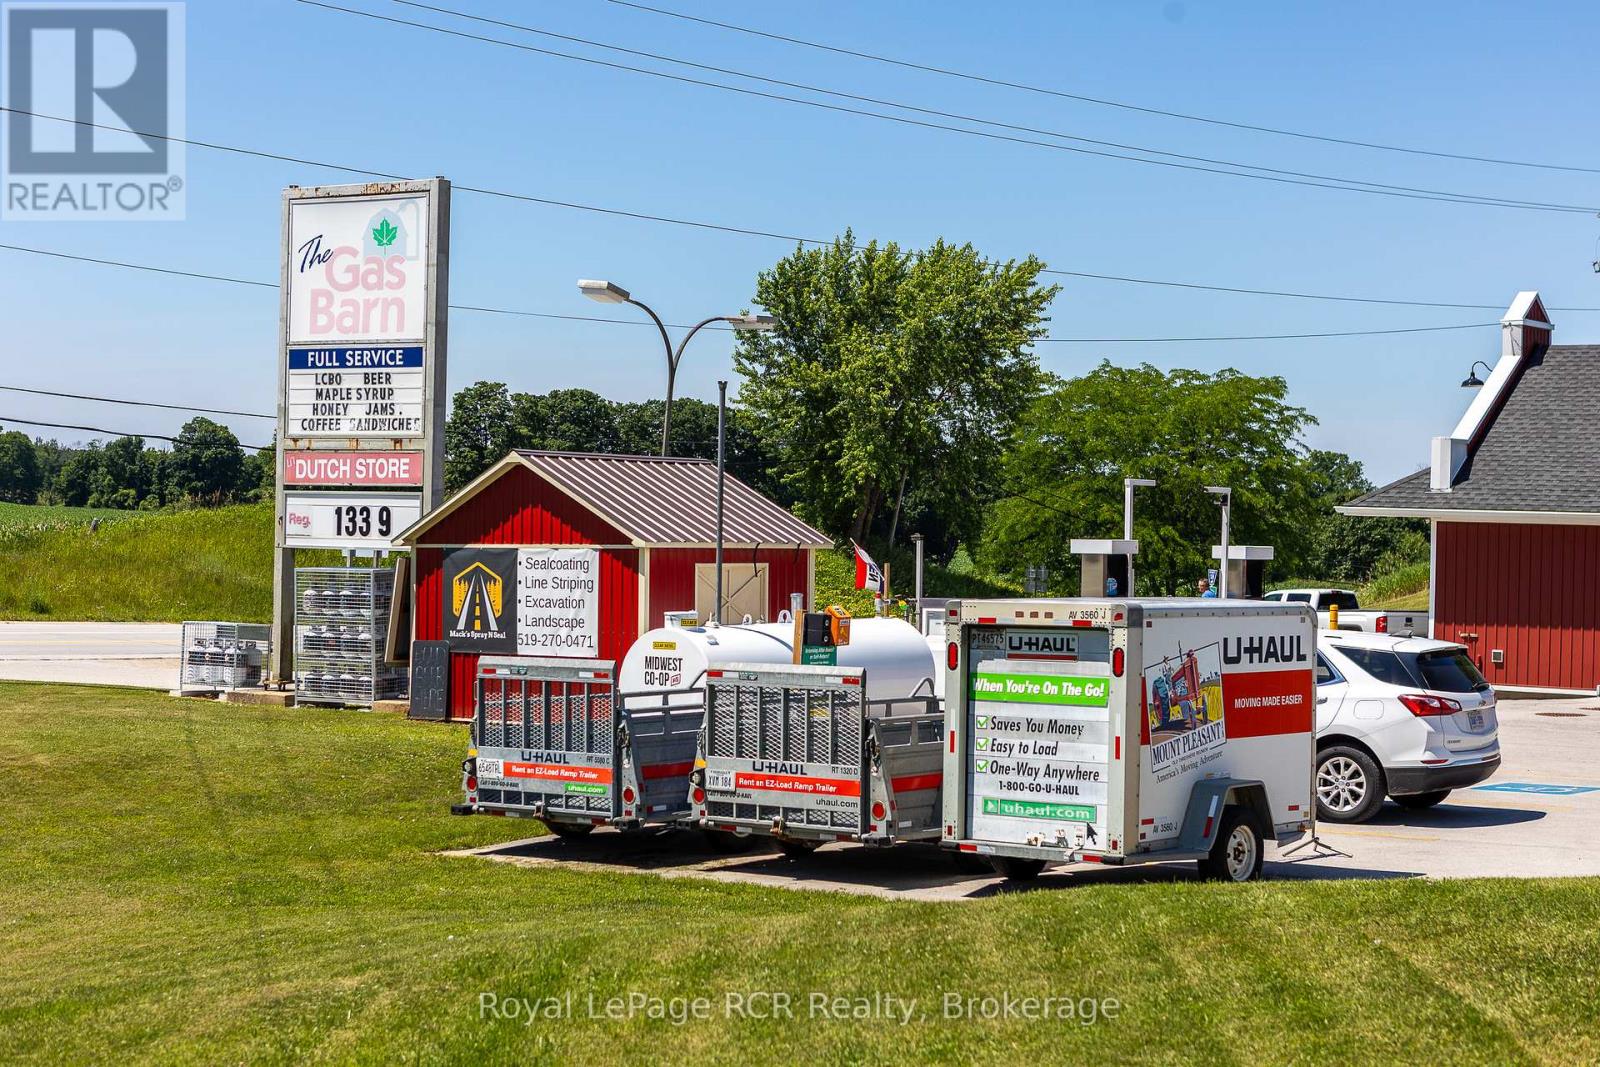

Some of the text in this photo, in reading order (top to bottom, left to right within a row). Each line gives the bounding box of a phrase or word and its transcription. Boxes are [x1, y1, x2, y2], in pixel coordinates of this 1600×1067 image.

[298, 234, 334, 273] The
[324, 245, 407, 292] Gas
[309, 288, 406, 335] Barn
[307, 349, 404, 367] FULL SERVICE
[314, 372, 392, 386] LCBO BEER
[315, 387, 395, 401] MAPLE SYRUP
[312, 402, 349, 416] HONEY
[301, 417, 342, 431] COFFEE
[295, 458, 351, 479] DUTCH
[354, 457, 410, 479] STORE
[288, 512, 311, 529] Reg.
[525, 556, 590, 574] Sealcoating
[525, 575, 595, 593] Line Striping
[525, 595, 585, 609] Excavation
[525, 614, 585, 631] Landscape
[1068, 610, 1106, 620] AV 3560 J
[449, 629, 506, 640] Mack's Spray N Seal
[517, 633, 594, 648] 519-270-0471
[1008, 635, 1077, 652] U-HAUL
[1223, 635, 1307, 665] U-HAUL
[644, 655, 683, 672] MIDWEST
[644, 671, 670, 686] CO-OP
[974, 678, 1105, 698] When You're On The Go!
[1234, 694, 1303, 709] MOVING MADE EASIER
[990, 715, 1085, 737] Saves You Money
[990, 737, 1059, 757] Easy to Load
[1152, 739, 1181, 766] MOUNT
[1182, 722, 1222, 753] PLEASANT
[521, 751, 570, 765] U-HAUL
[511, 765, 599, 779] Rent an EZ-Load Ramp Trailer
[752, 760, 808, 776] U-HAUL
[831, 766, 838, 774] RT
[840, 766, 852, 775] 1320
[989, 759, 1100, 783] One-Way Anywhere
[567, 785, 604, 793] uhaul.com
[739, 777, 755, 786] Rent
[765, 779, 793, 789] EZ-Load
[793, 781, 814, 793] Ramp
[815, 783, 838, 793] Trailer
[999, 780, 1080, 796] 1-800-GO-U-HAUL
[816, 799, 859, 808] uhaul.com
[1004, 803, 1090, 819] uhaul.com
